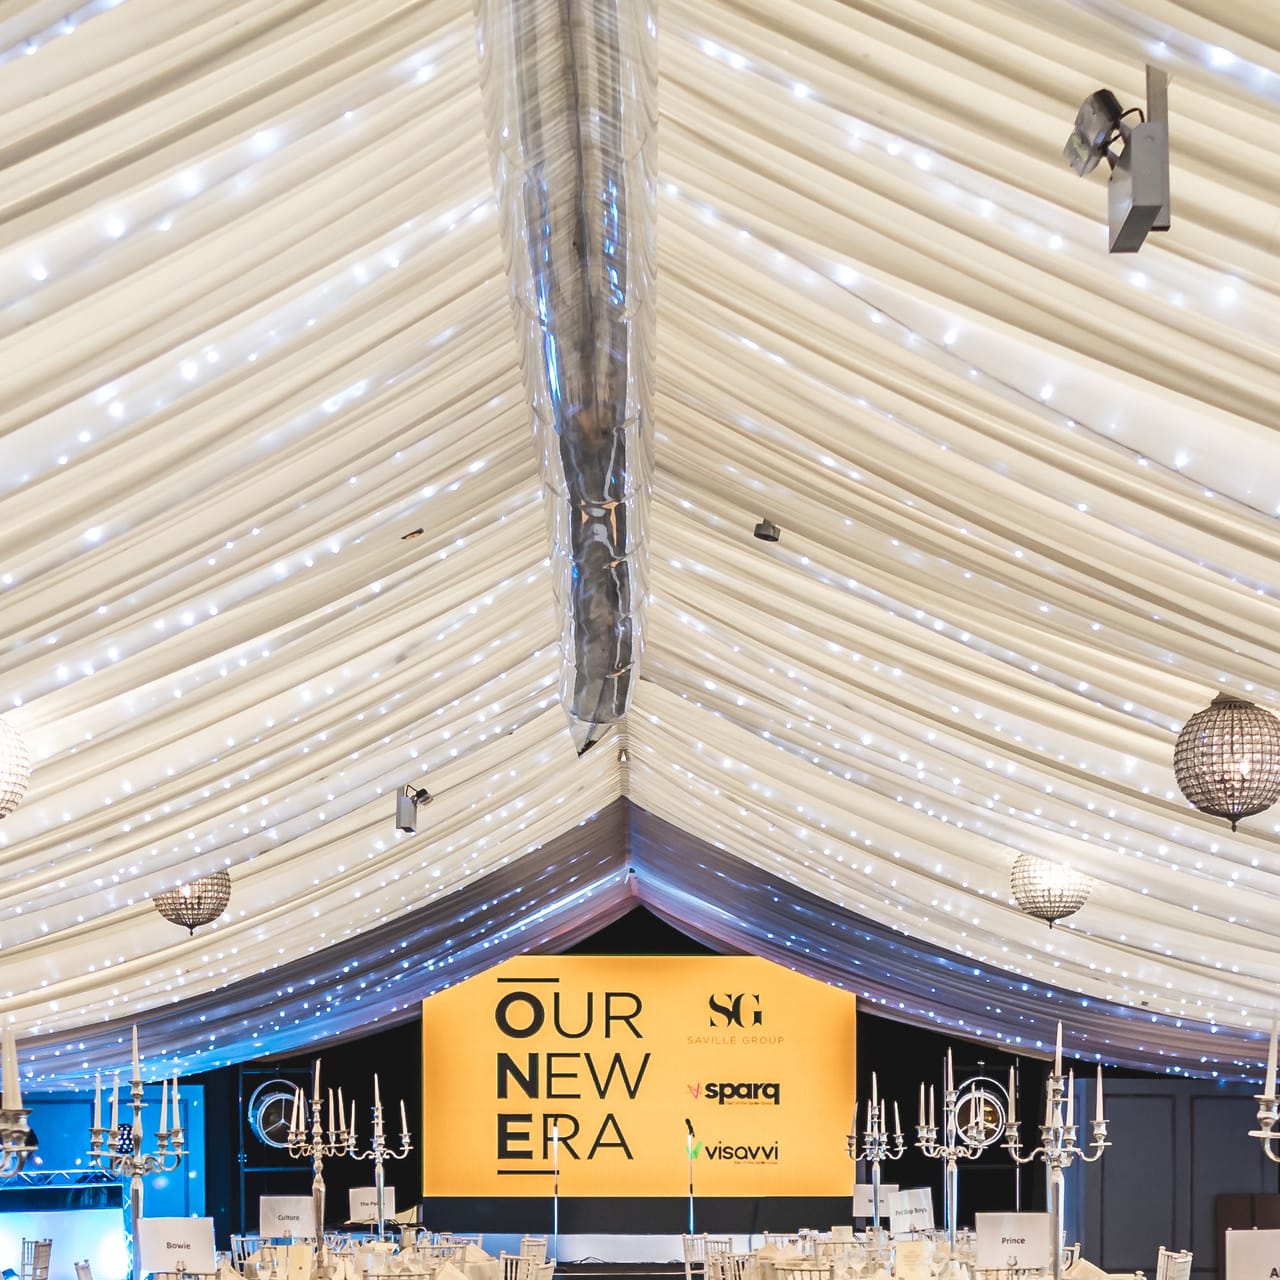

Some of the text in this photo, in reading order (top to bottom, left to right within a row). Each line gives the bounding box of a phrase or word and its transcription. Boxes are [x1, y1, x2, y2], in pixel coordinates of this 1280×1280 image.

[495, 991, 643, 1038] OUR
[709, 993, 762, 1028] SG
[687, 1036, 785, 1045] SAVILLE GROUP
[497, 1053, 651, 1099] NEW
[705, 1083, 780, 1105] sparq
[497, 1113, 634, 1160] ERA
[705, 1141, 778, 1160] visavvi
[1001, 1237, 1025, 1245] Prince
